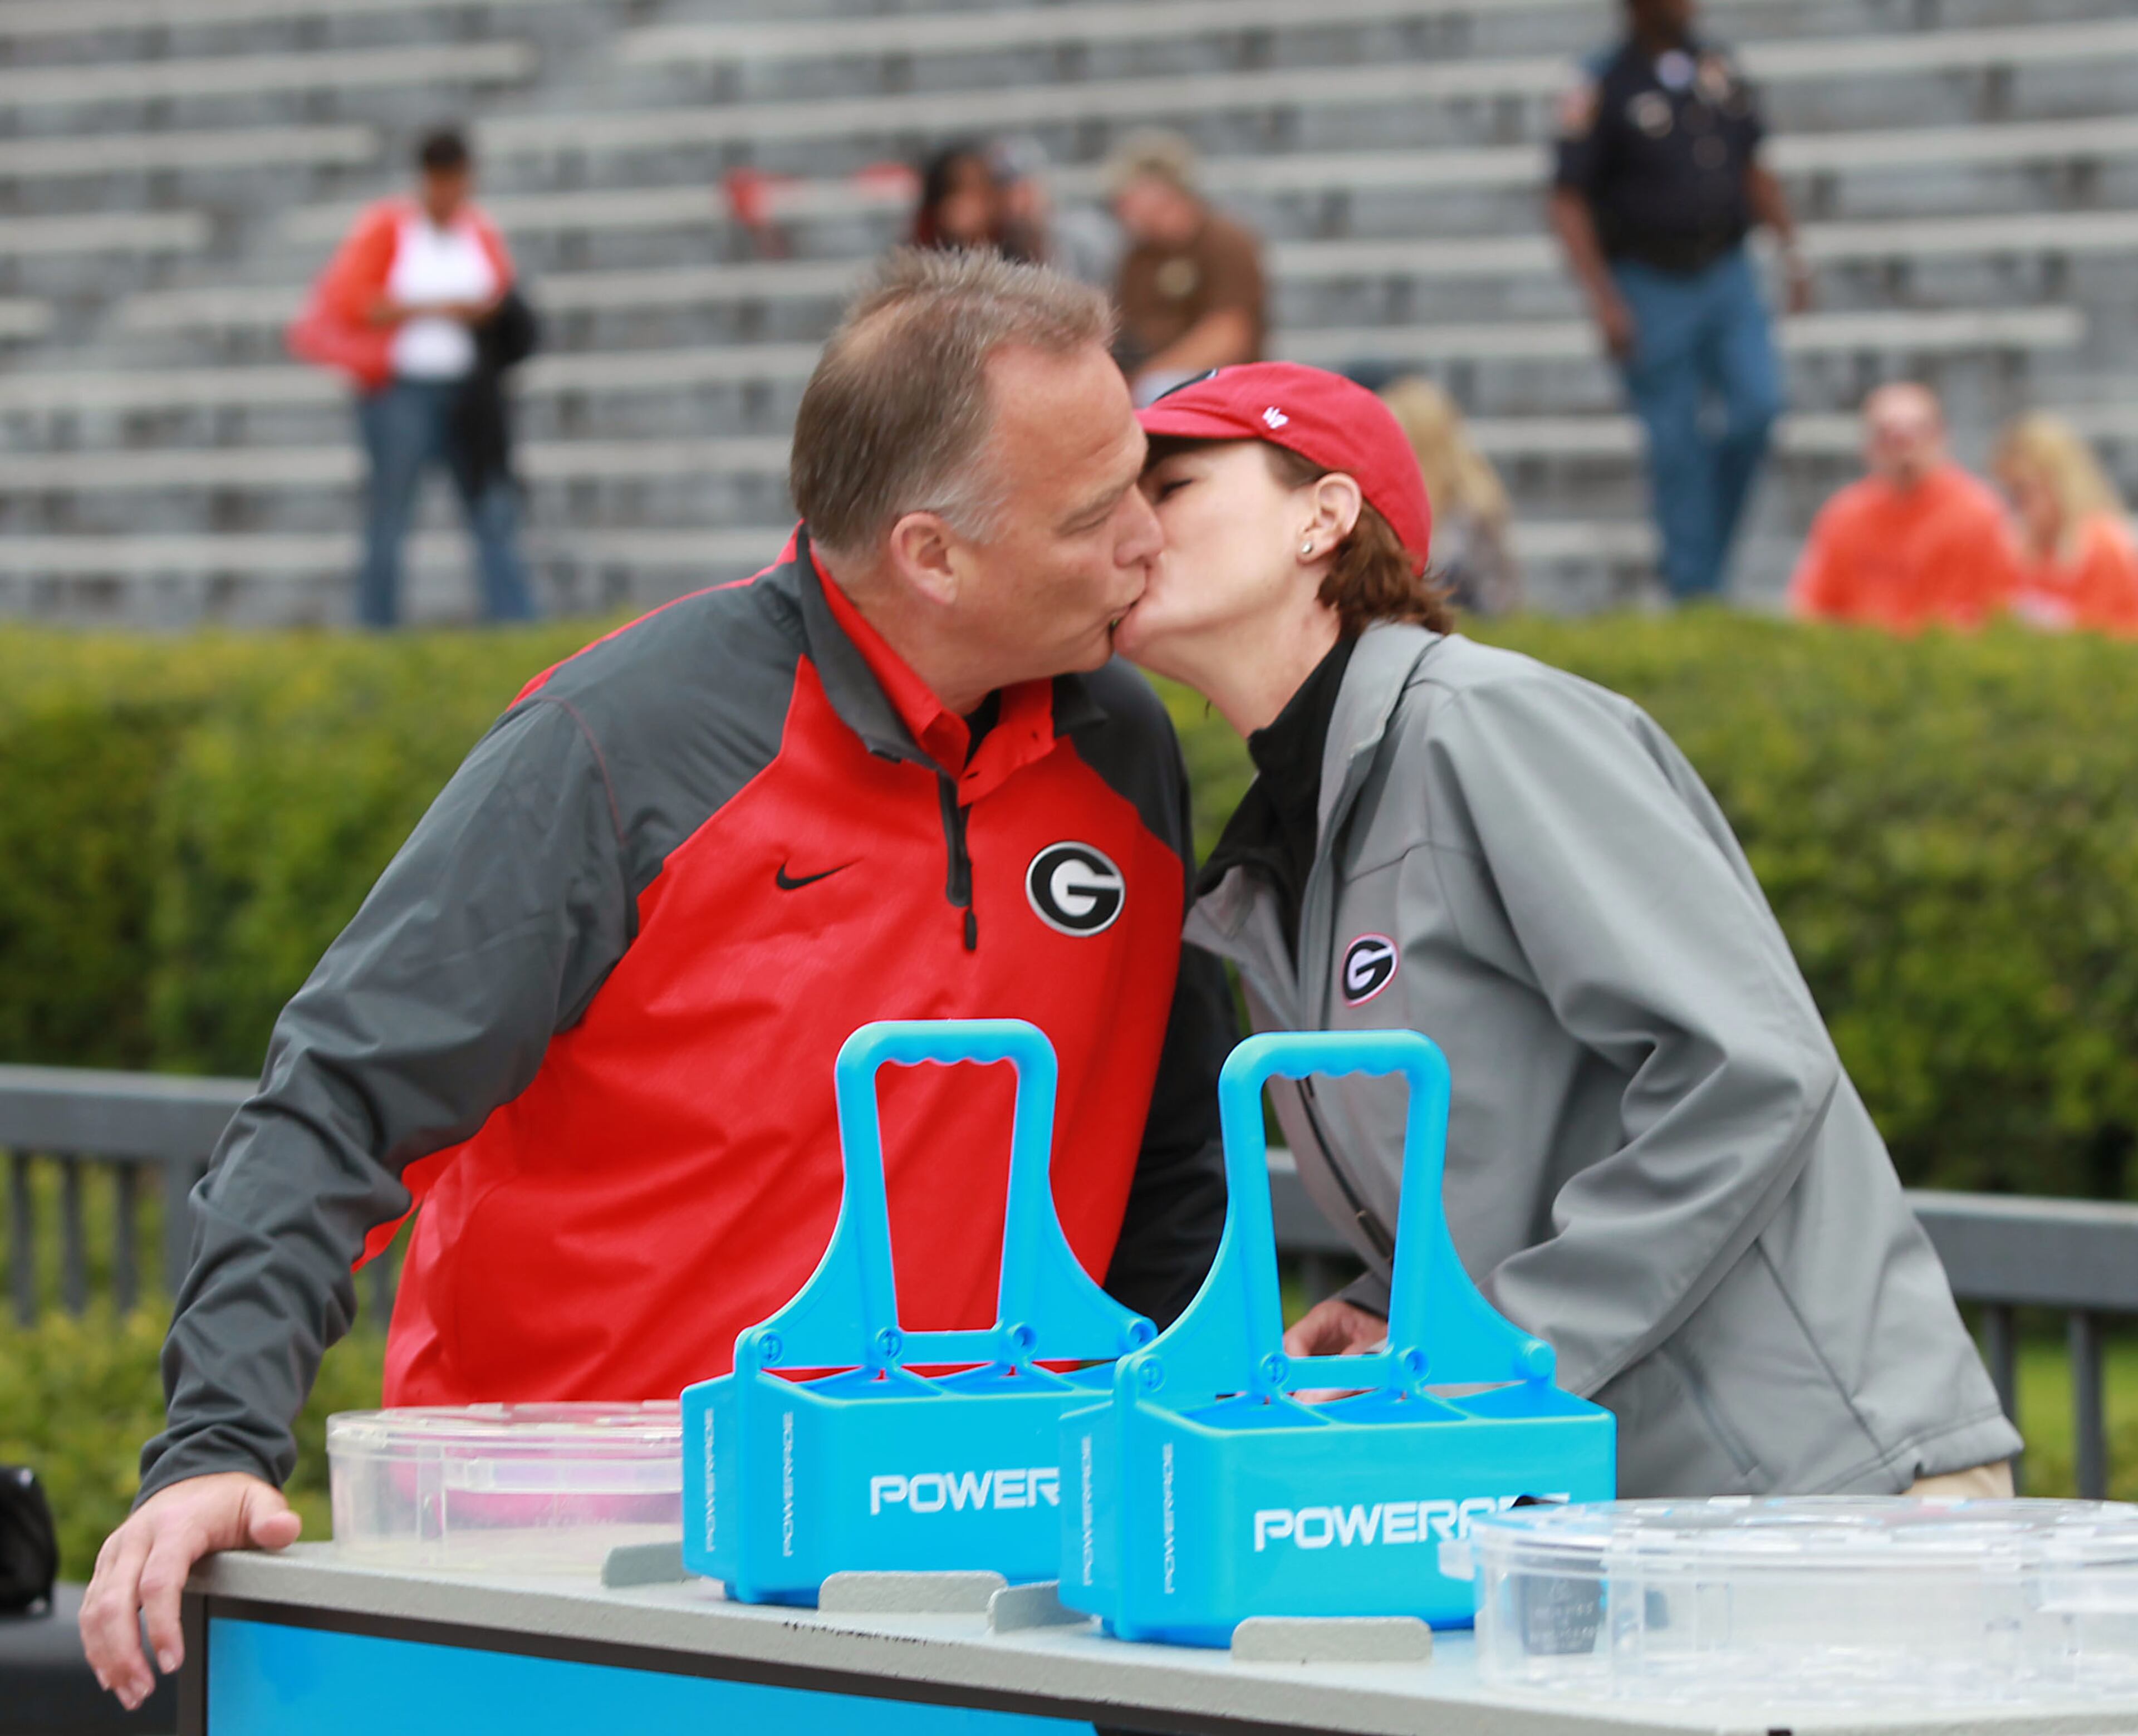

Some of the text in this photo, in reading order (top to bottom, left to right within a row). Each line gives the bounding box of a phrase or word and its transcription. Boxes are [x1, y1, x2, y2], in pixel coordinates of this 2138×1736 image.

[1026, 841, 1124, 936] G
[1341, 934, 1399, 1006] G
[704, 1408, 715, 1552] POWERADE
[783, 1412, 793, 1557] POWERADE
[870, 1468, 1059, 1515] POWER
[1081, 1436, 1093, 1586] POWERADE
[1163, 1443, 1175, 1593] POWERADE
[1254, 1492, 1570, 1552] POWERA
